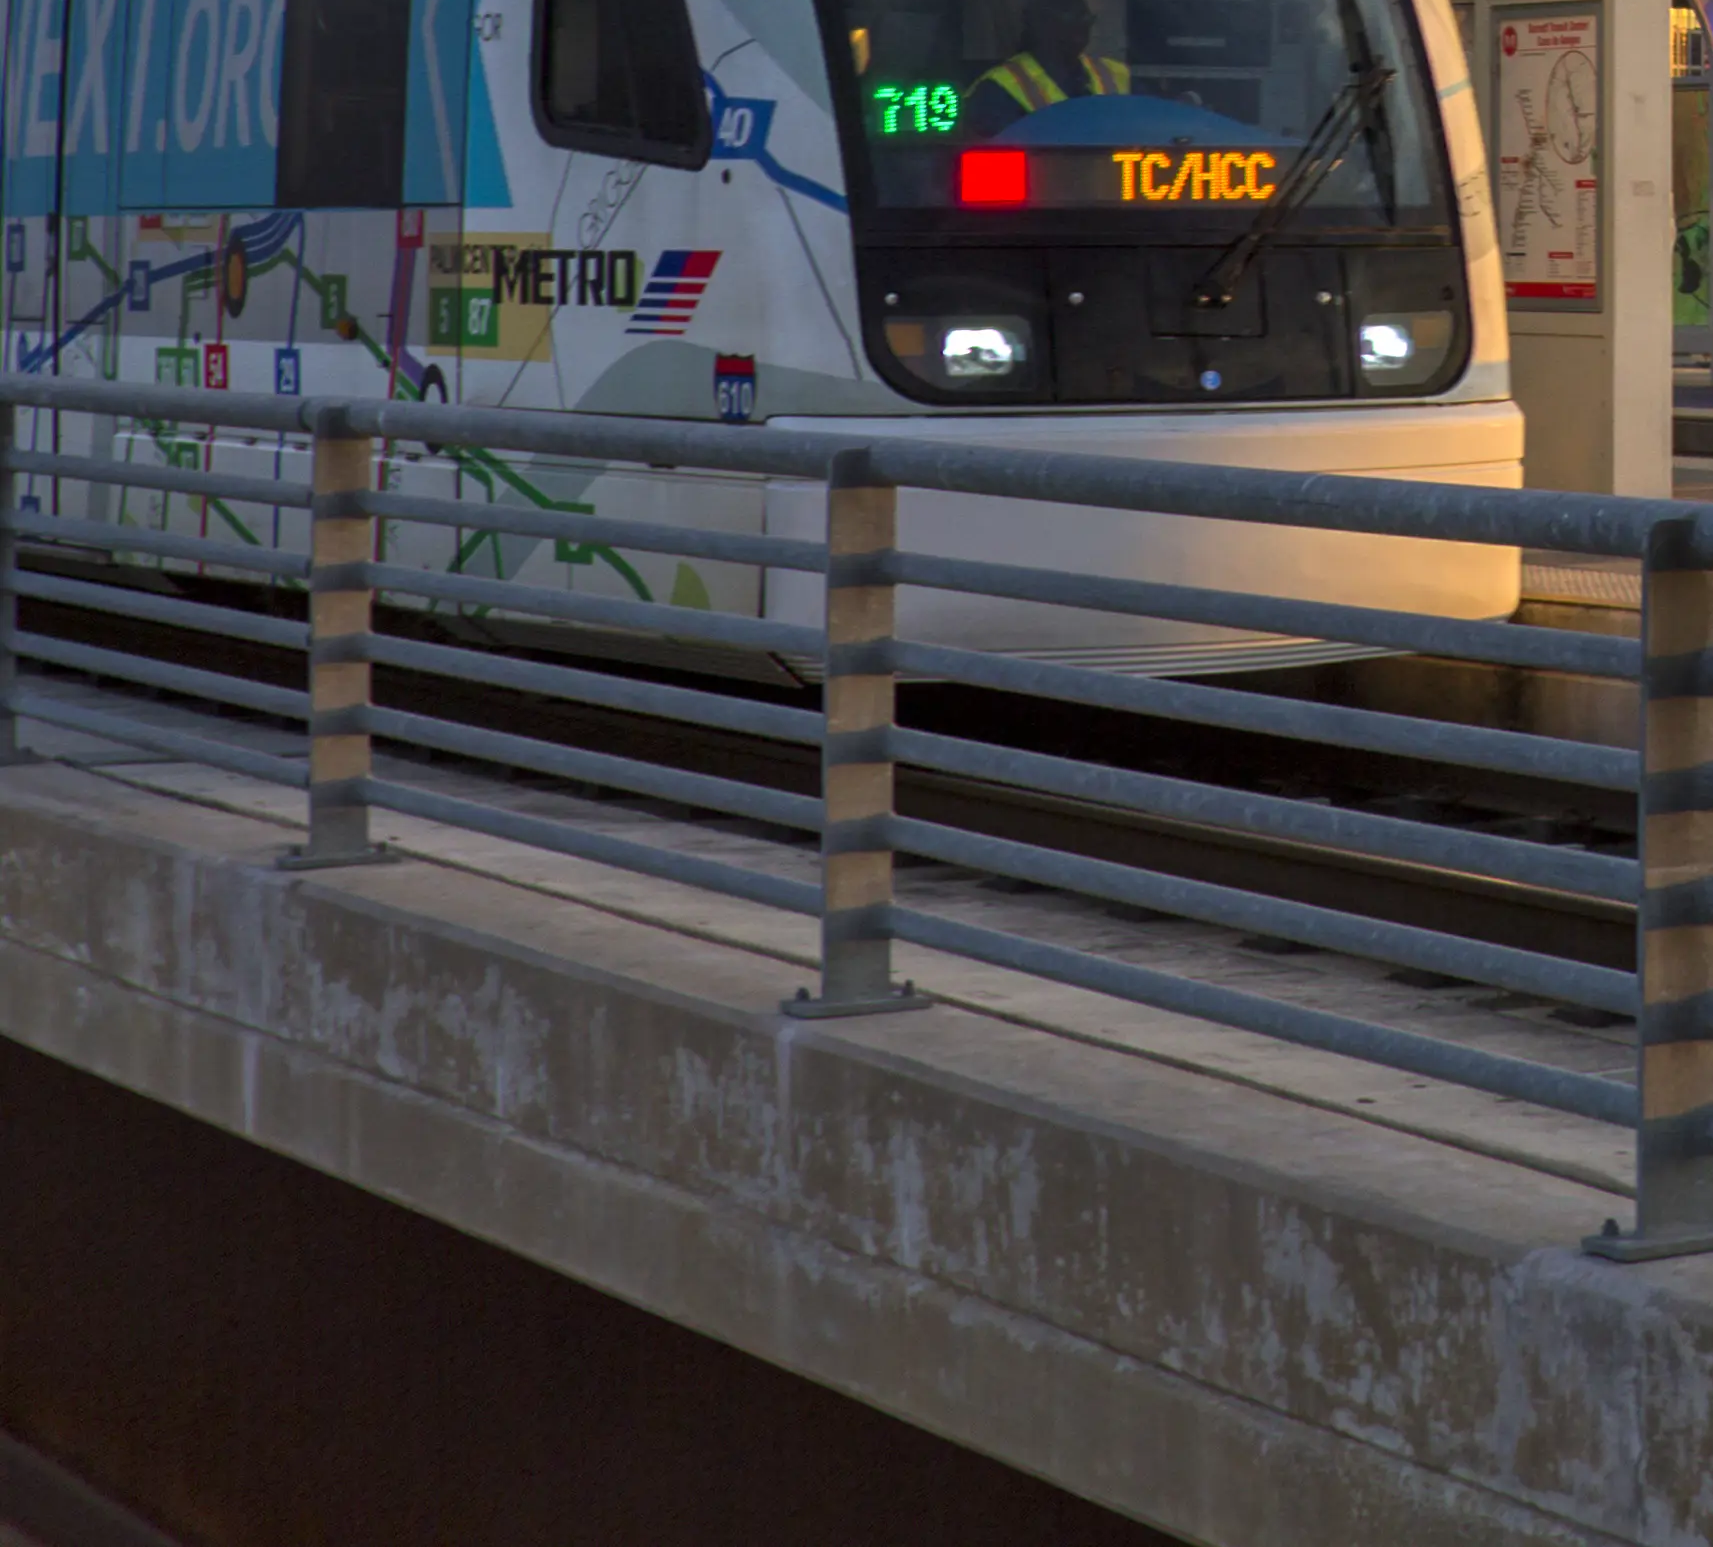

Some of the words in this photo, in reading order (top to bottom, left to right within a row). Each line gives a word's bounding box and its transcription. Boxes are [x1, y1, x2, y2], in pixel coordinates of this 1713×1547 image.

[718, 106, 754, 148] 40
[873, 85, 959, 133] 719
[1111, 151, 1277, 201] TC/HCC
[493, 249, 636, 307] METRO
[467, 297, 493, 337] 87
[718, 381, 752, 415] 610
